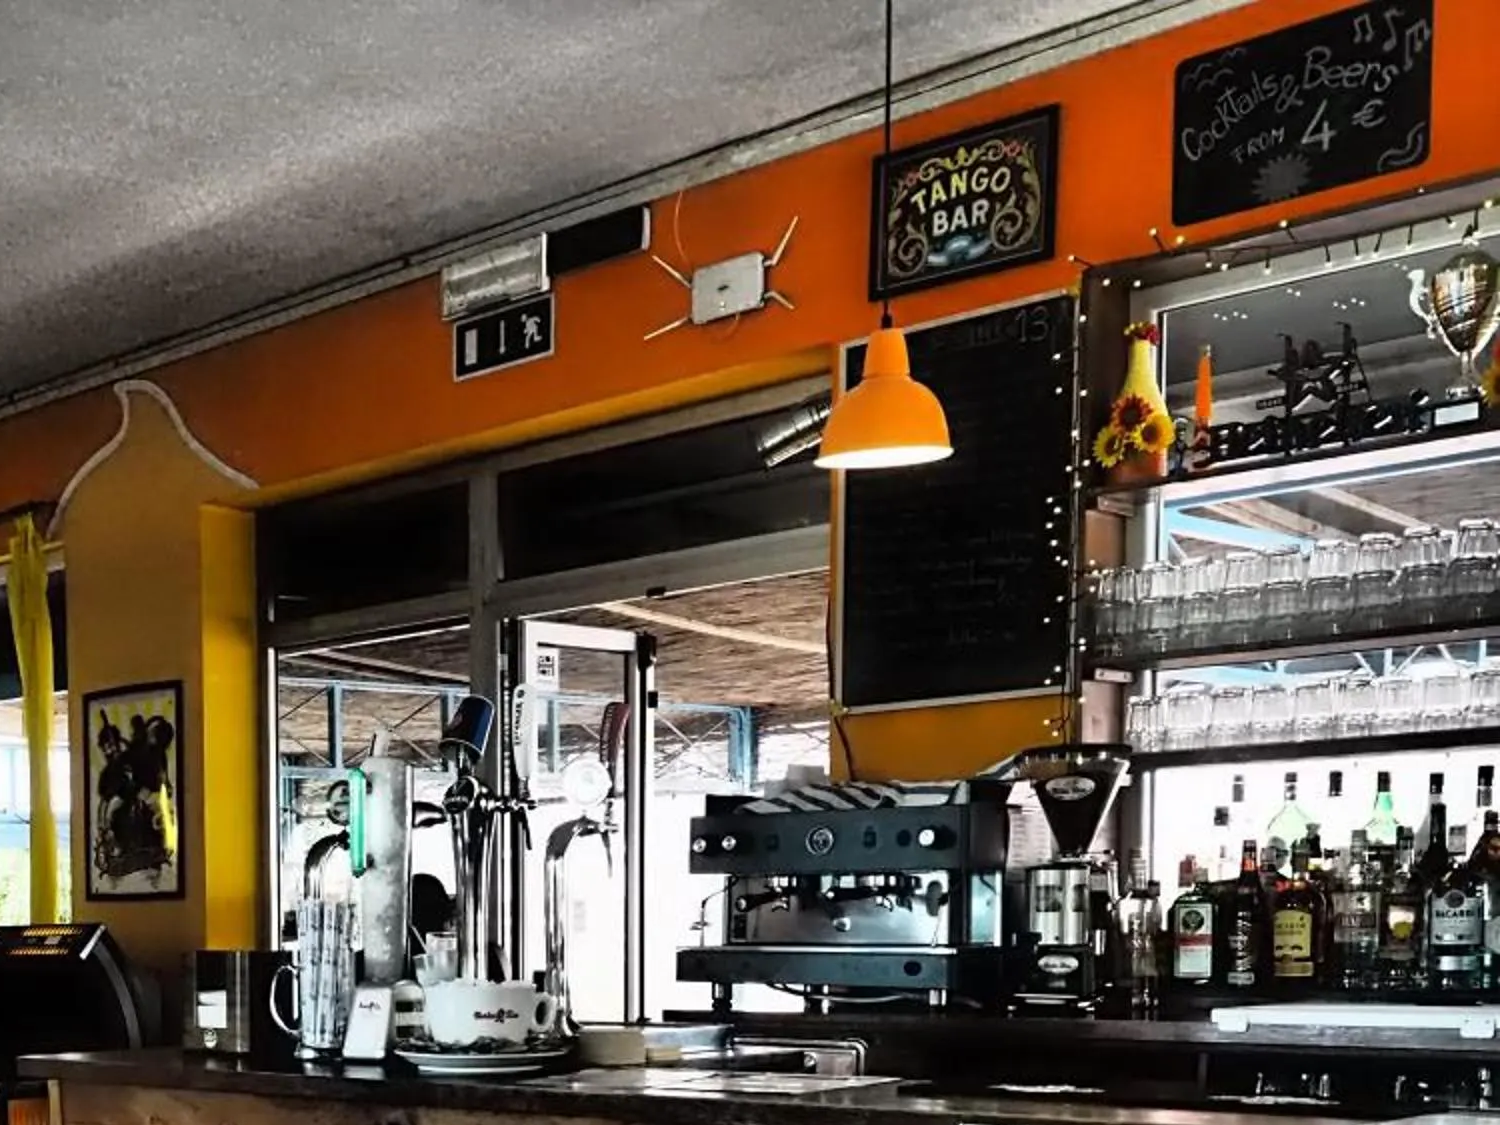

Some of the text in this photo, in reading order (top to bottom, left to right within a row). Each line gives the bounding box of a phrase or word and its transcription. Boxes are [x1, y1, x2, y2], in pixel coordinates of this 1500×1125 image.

[1181, 46, 1399, 161] Cocktails & Beers
[1232, 99, 1386, 164] FROM 4 €
[910, 166, 1011, 214] TANGO
[932, 198, 990, 237] BAR
